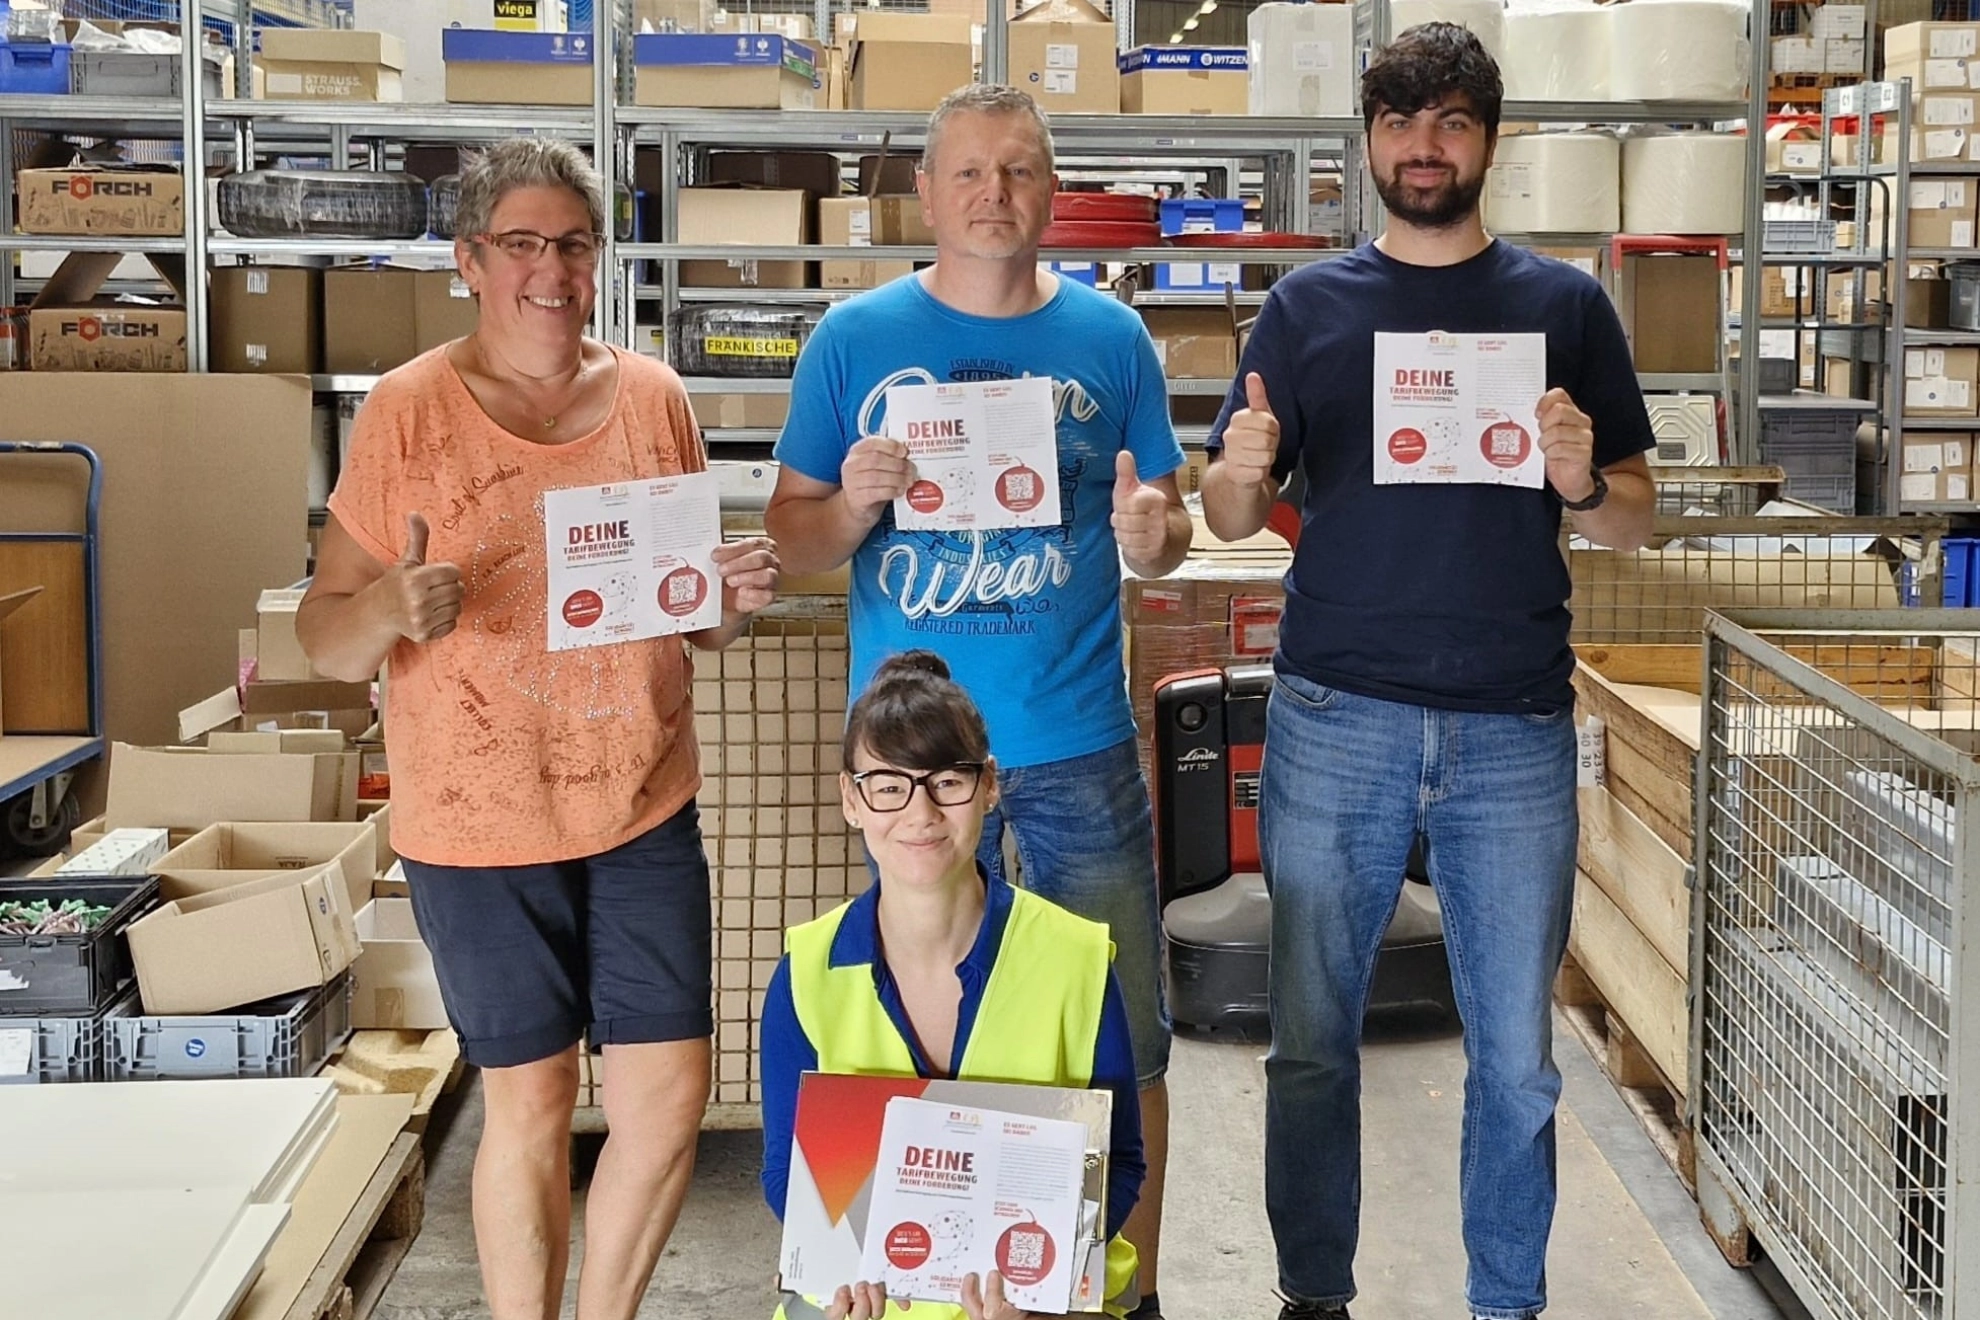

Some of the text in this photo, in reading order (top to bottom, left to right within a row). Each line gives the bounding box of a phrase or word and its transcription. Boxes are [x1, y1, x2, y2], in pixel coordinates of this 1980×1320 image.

[498, 1, 533, 17] viega
[306, 84, 350, 96] WORKS
[1395, 369, 1455, 387] DEINE
[1389, 387, 1460, 396] TARIFBEWEGUNG
[907, 418, 966, 439] DEINE
[568, 520, 630, 545] DEINE
[563, 539, 636, 555] TARIFBEWEGUNG
[879, 531, 1072, 618] Wear
[967, 620, 1036, 635] TRADEMARK
[1177, 747, 1219, 761] Linde
[1581, 754, 1592, 768] 30
[904, 1146, 975, 1173] DEINE
[896, 1167, 978, 1184] TARIFBEWEGUNG
